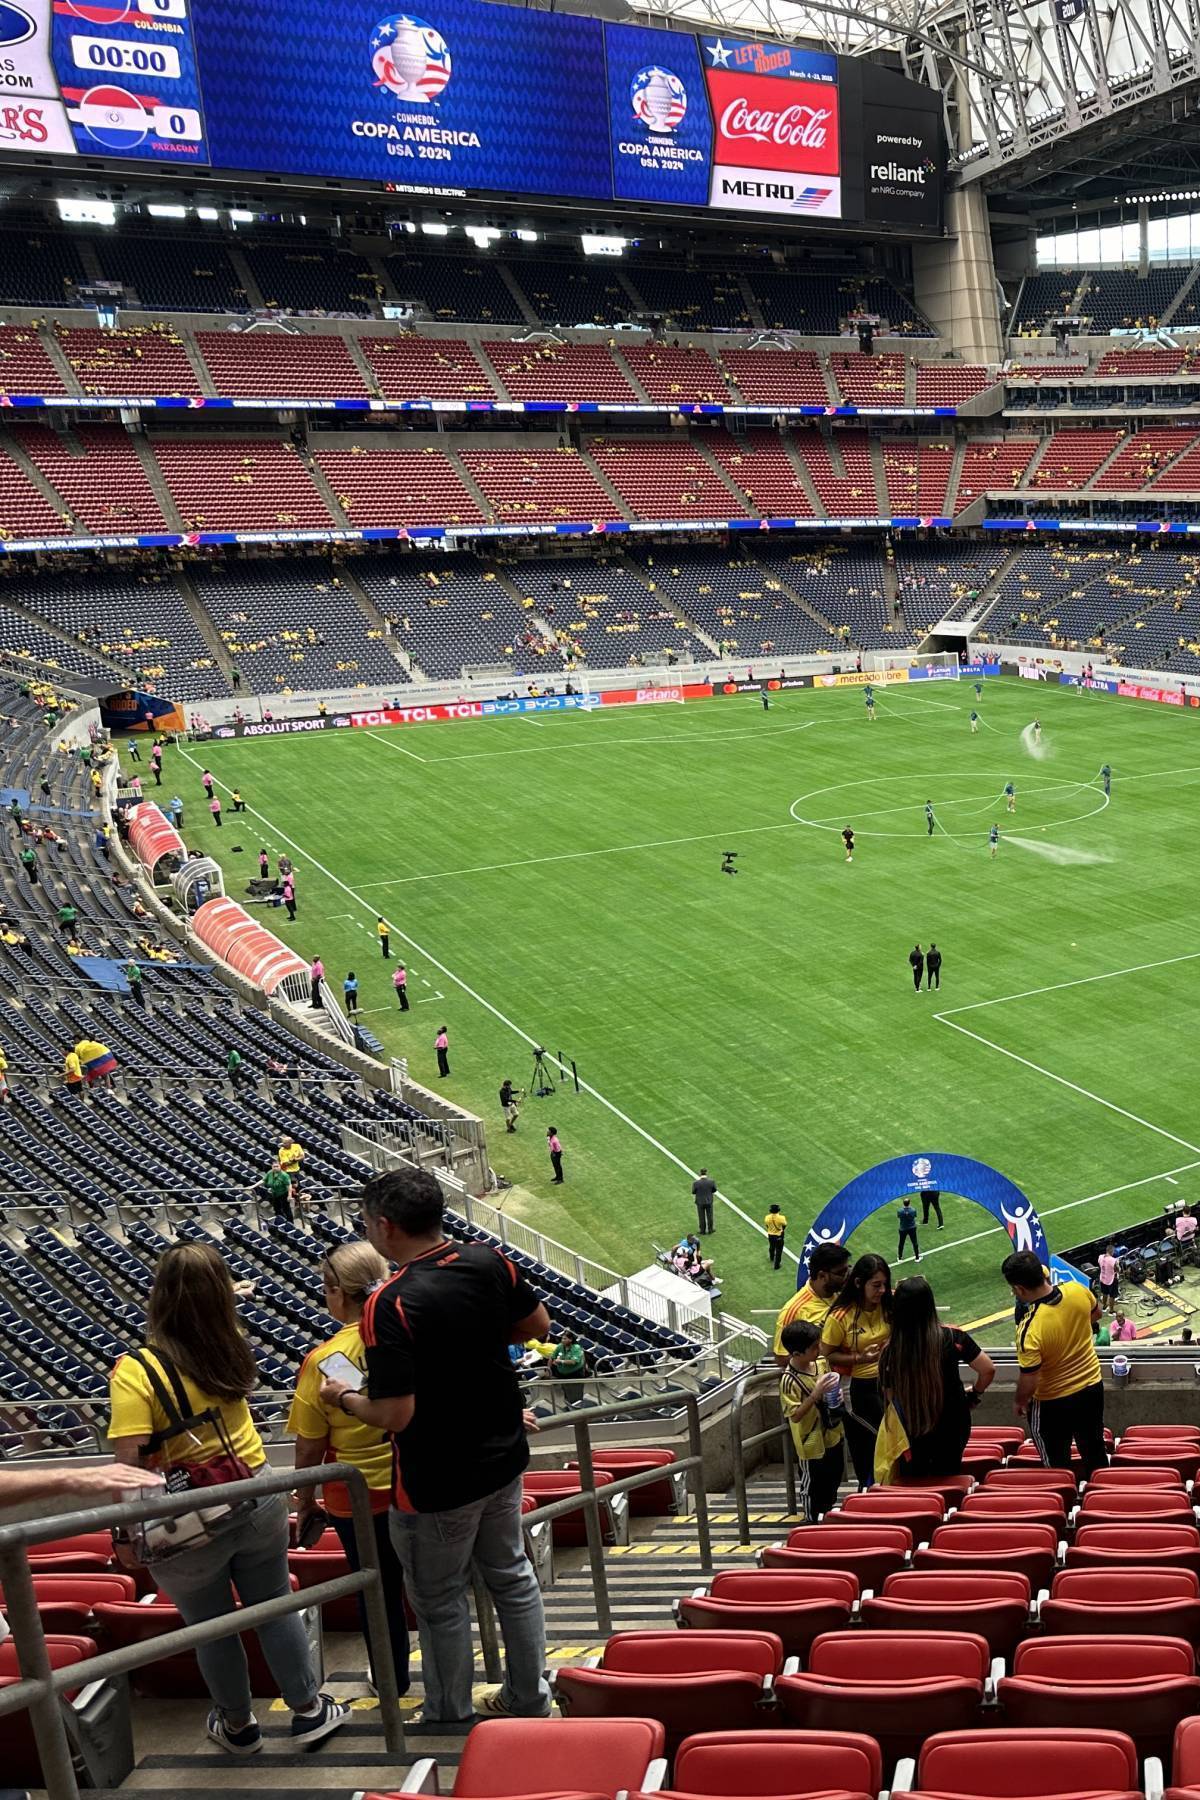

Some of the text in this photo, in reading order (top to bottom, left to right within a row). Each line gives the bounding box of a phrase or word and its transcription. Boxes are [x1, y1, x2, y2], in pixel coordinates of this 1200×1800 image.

[134, 20, 184, 35] COLOMBIA
[88, 44, 166, 72] 00:00
[735, 43, 764, 65] LET'S
[754, 49, 791, 73] RODEO
[789, 70, 805, 78] March
[169, 115, 186, 134] 0
[396, 113, 437, 126] CONMEBOL
[720, 98, 832, 148] Coca-Cola
[352, 121, 481, 147] COPA AMERICA
[876, 134, 922, 148] powered by
[152, 143, 199, 154] PARAGUAY
[386, 143, 451, 160] USA 2024
[618, 142, 703, 161] COPA AMERICA
[640, 158, 683, 170] USA 2024
[870, 162, 926, 183] reliant
[395, 184, 466, 197] MITSUBISHI ELECTRIC
[722, 179, 794, 200] METRO
[880, 186, 896, 195] NRG
[896, 188, 925, 199] company
[840, 672, 880, 684] mercado
[636, 690, 679, 702] Betano
[444, 703, 482, 717] TCL
[484, 702, 520, 713] BYD
[525, 700, 560, 711] BYD
[354, 712, 392, 726] TCL
[400, 708, 437, 722] TCL
[243, 722, 292, 736] ABSOLUT
[293, 719, 325, 732] SPORT
